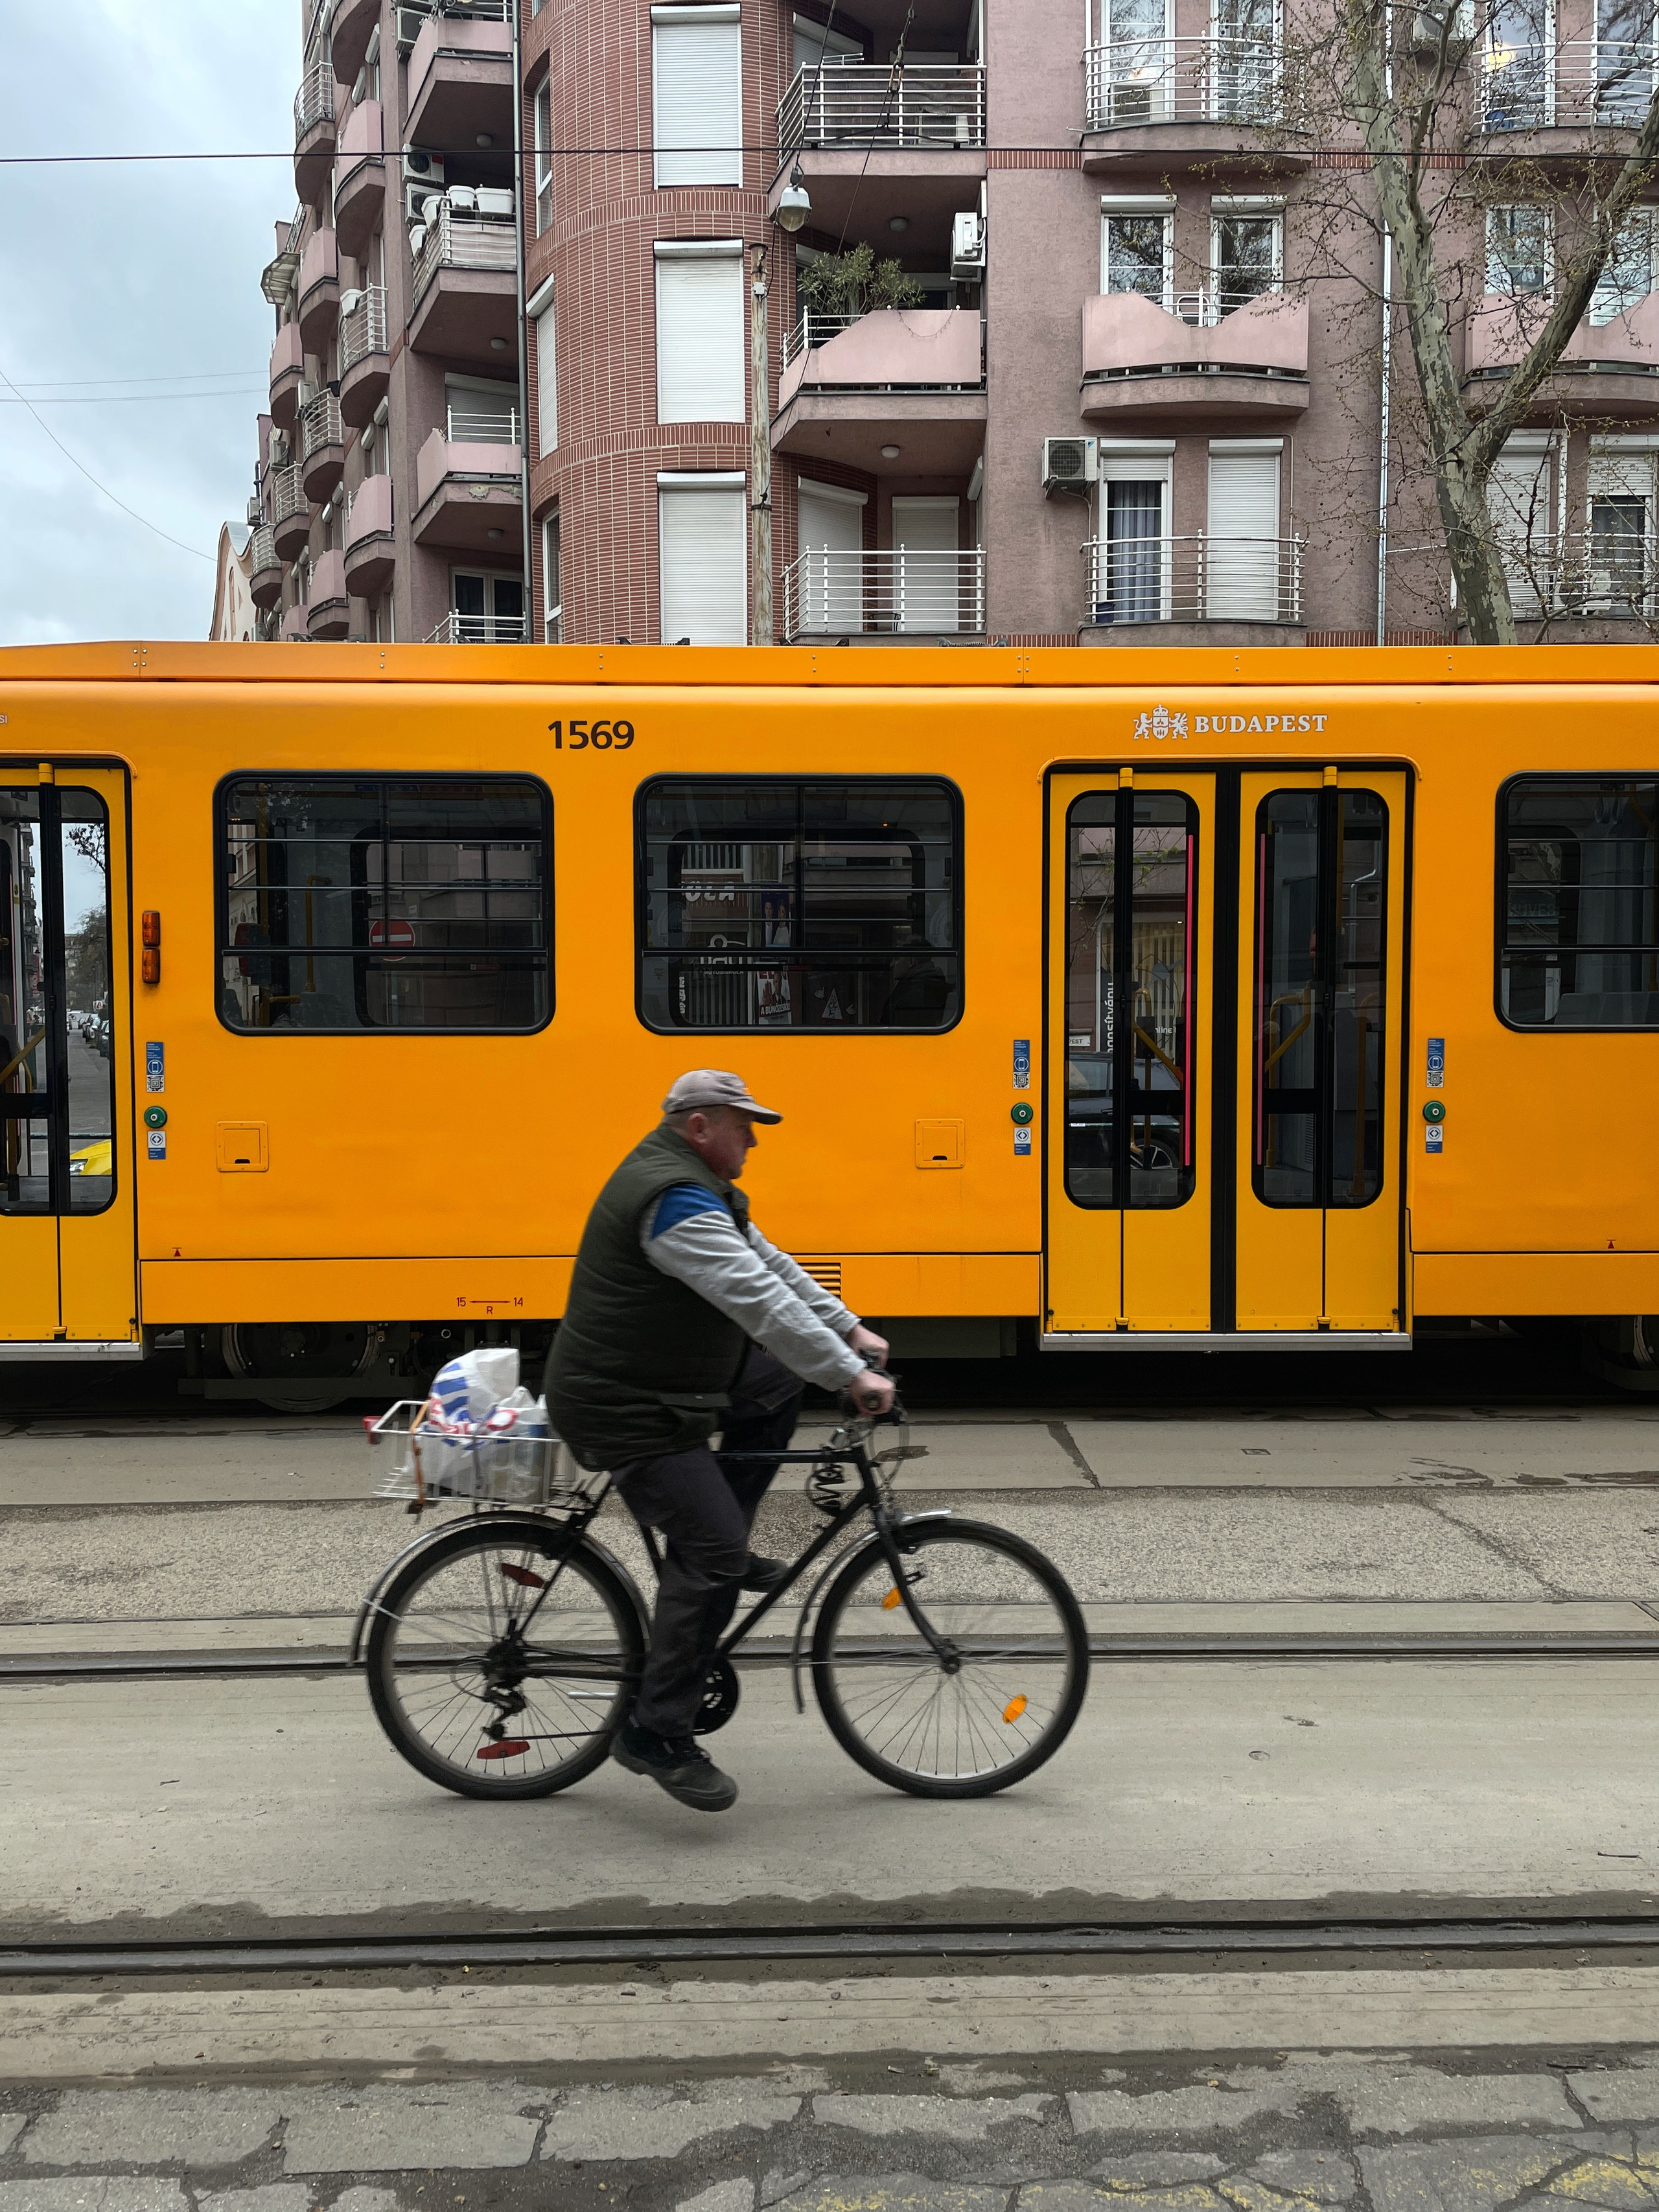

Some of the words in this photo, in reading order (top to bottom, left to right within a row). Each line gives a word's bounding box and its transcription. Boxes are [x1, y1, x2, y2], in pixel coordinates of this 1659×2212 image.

[1194, 715, 1328, 732] BUDAPEST
[548, 720, 635, 749] 1569
[456, 1297, 467, 1307] 15
[513, 1297, 524, 1307] 14
[486, 1306, 493, 1314] R
